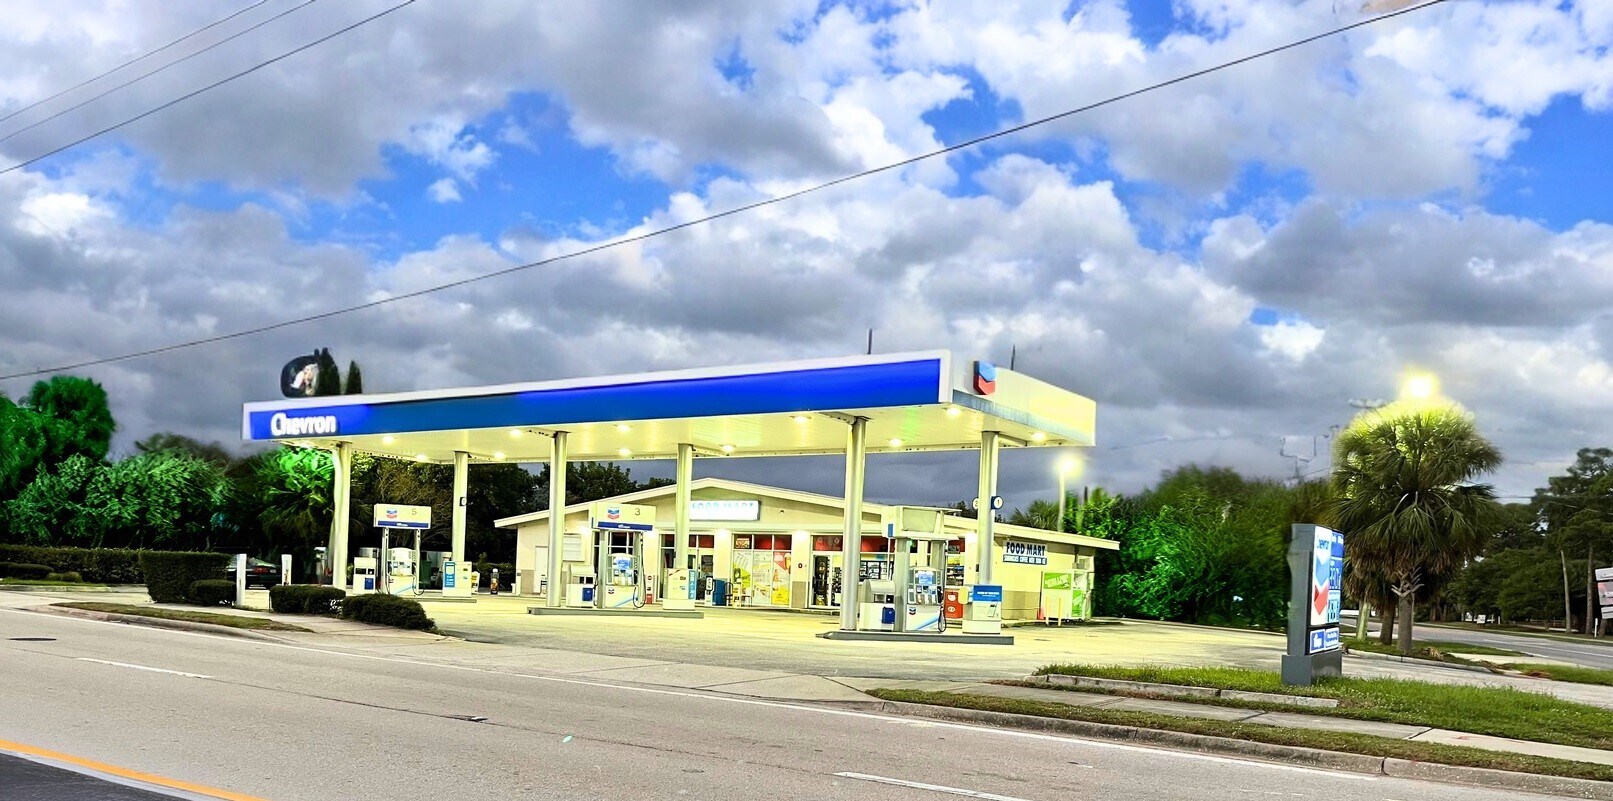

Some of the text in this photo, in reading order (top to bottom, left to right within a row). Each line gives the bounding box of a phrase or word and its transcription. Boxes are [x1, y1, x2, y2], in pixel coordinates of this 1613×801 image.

[271, 412, 336, 436] Chevron
[635, 508, 641, 516] 3
[1006, 541, 1045, 556] FOOD MART
